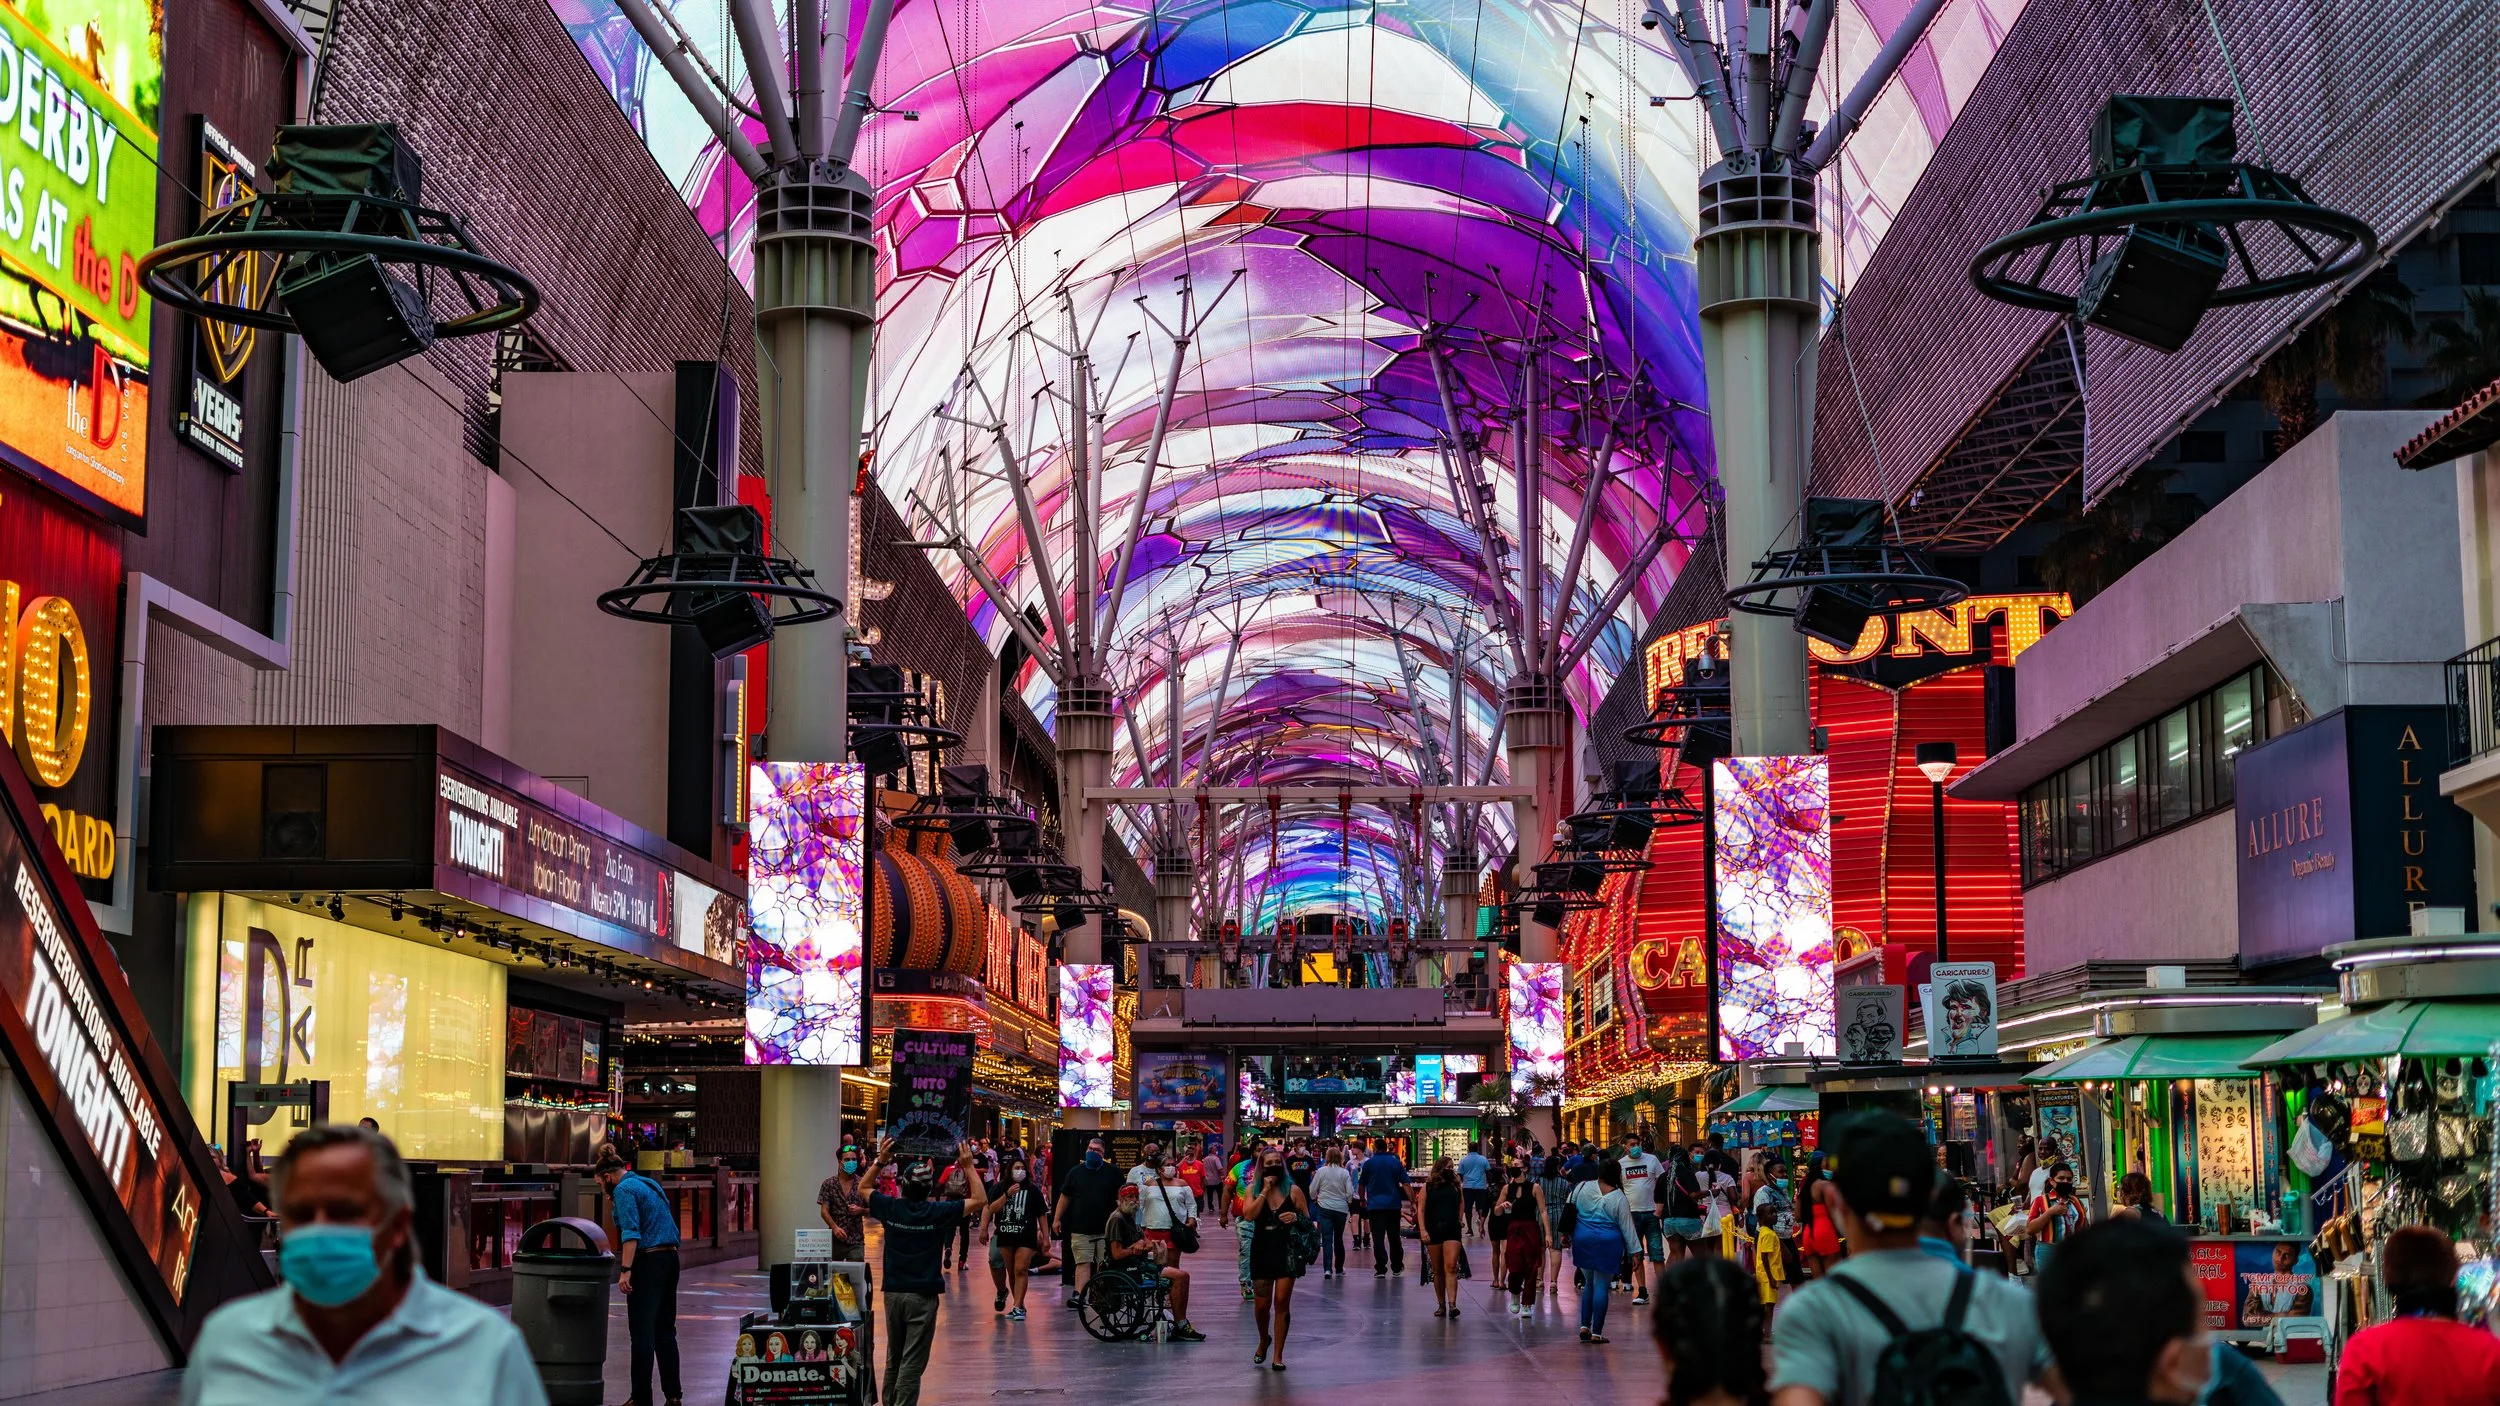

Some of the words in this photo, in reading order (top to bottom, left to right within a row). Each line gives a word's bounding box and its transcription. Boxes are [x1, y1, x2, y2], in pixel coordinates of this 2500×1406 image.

[30, 188, 68, 270] AT
[73, 215, 111, 305] the
[119, 251, 138, 320] D
[66, 379, 88, 439] the
[89, 343, 120, 451] D
[197, 377, 241, 443] VEGAS
[190, 424, 216, 450] GOLDEN
[215, 441, 244, 468] KNIGHTS
[488, 796, 519, 829] AVAILABLE
[2247, 796, 2324, 860] ALLURE
[449, 810, 504, 878] TONIGHT!
[528, 817, 568, 860] American
[568, 833, 591, 870] Prime
[1935, 968, 1990, 978] CARICATURES!
[1848, 989, 1892, 998] CARICATURES!
[903, 1041, 967, 1056] CULTURE
[24, 949, 132, 1188] TONIGHT!
[912, 1077, 947, 1090] INTO
[108, 1046, 162, 1161] AVAILABLE
[1000, 1225, 1025, 1233] OBEY
[2196, 1247, 2227, 1260] ALL
[2240, 1272, 2315, 1284] TEMPORARY
[2248, 1283, 2309, 1297] TATTOO
[743, 1365, 826, 1384] Donate.
